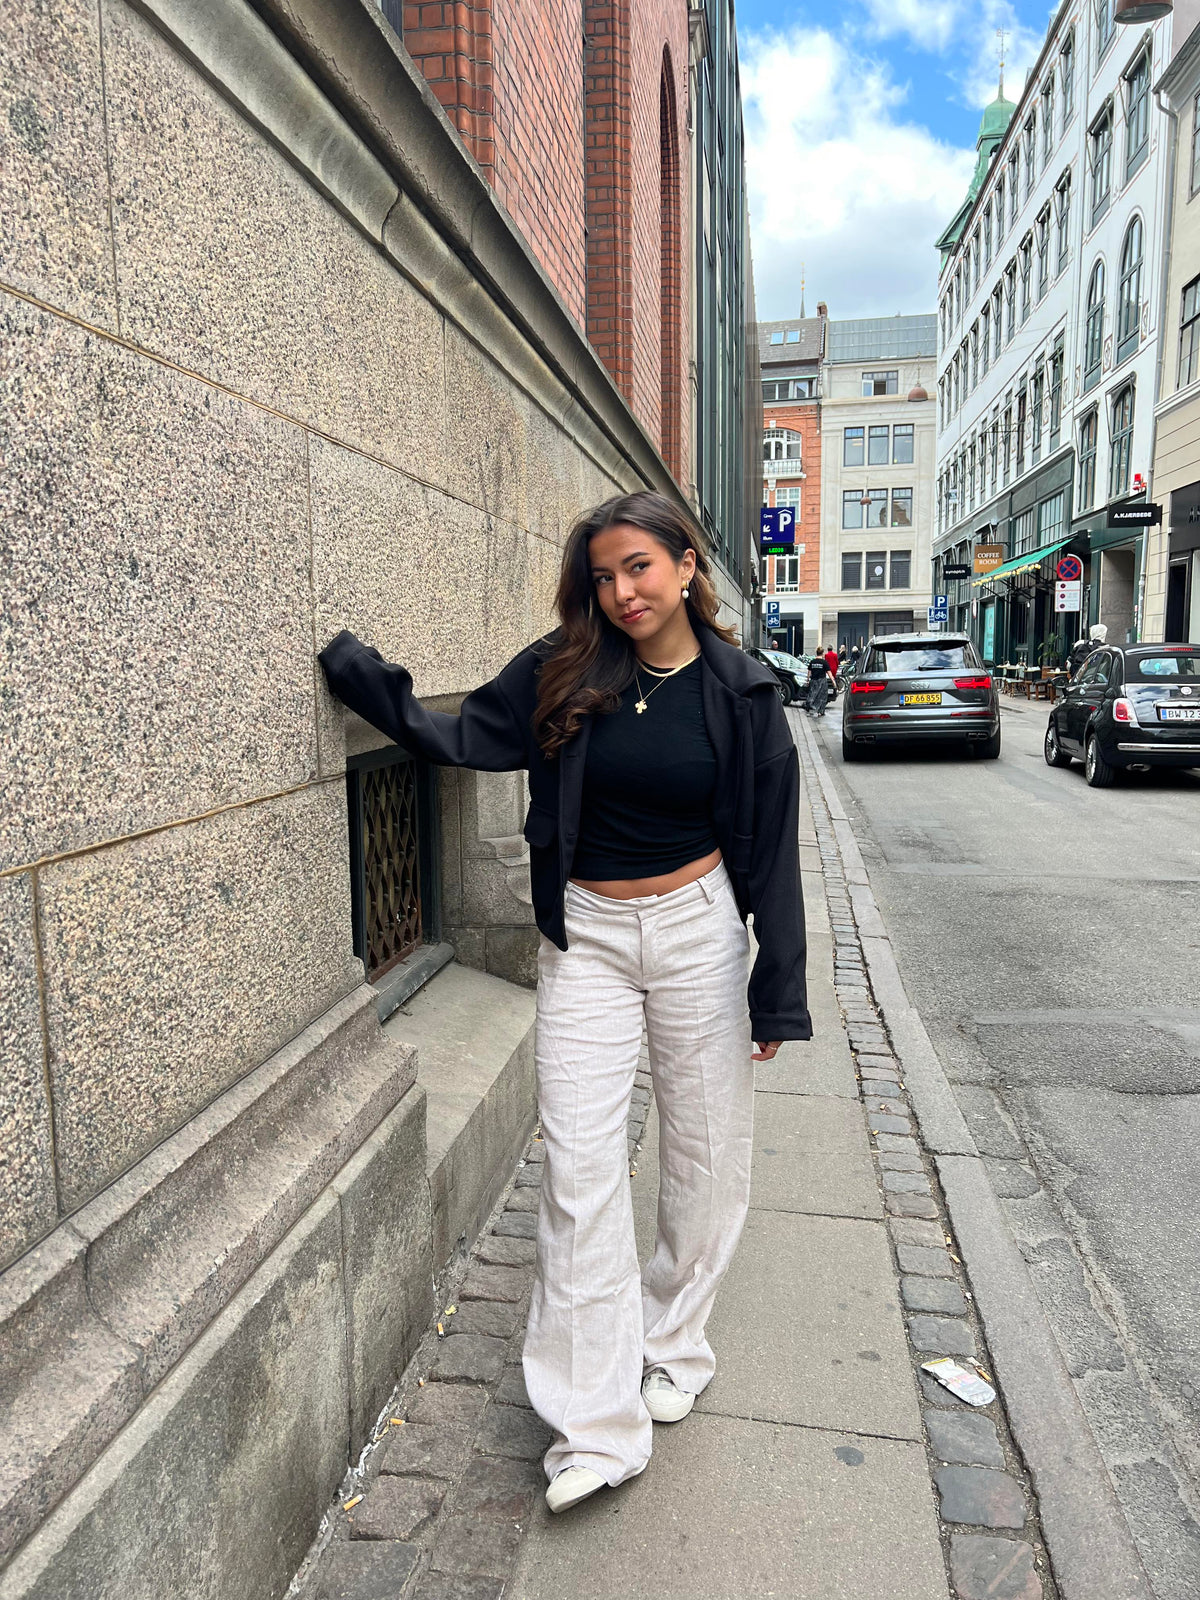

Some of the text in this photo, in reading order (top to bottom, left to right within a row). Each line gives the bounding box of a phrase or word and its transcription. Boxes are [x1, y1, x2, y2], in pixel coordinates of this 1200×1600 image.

[779, 513, 792, 532] P
[770, 602, 778, 613] P
[937, 596, 946, 608] P
[926, 694, 940, 702] 855
[1168, 710, 1181, 718] BW
[1184, 710, 1195, 718] 12
